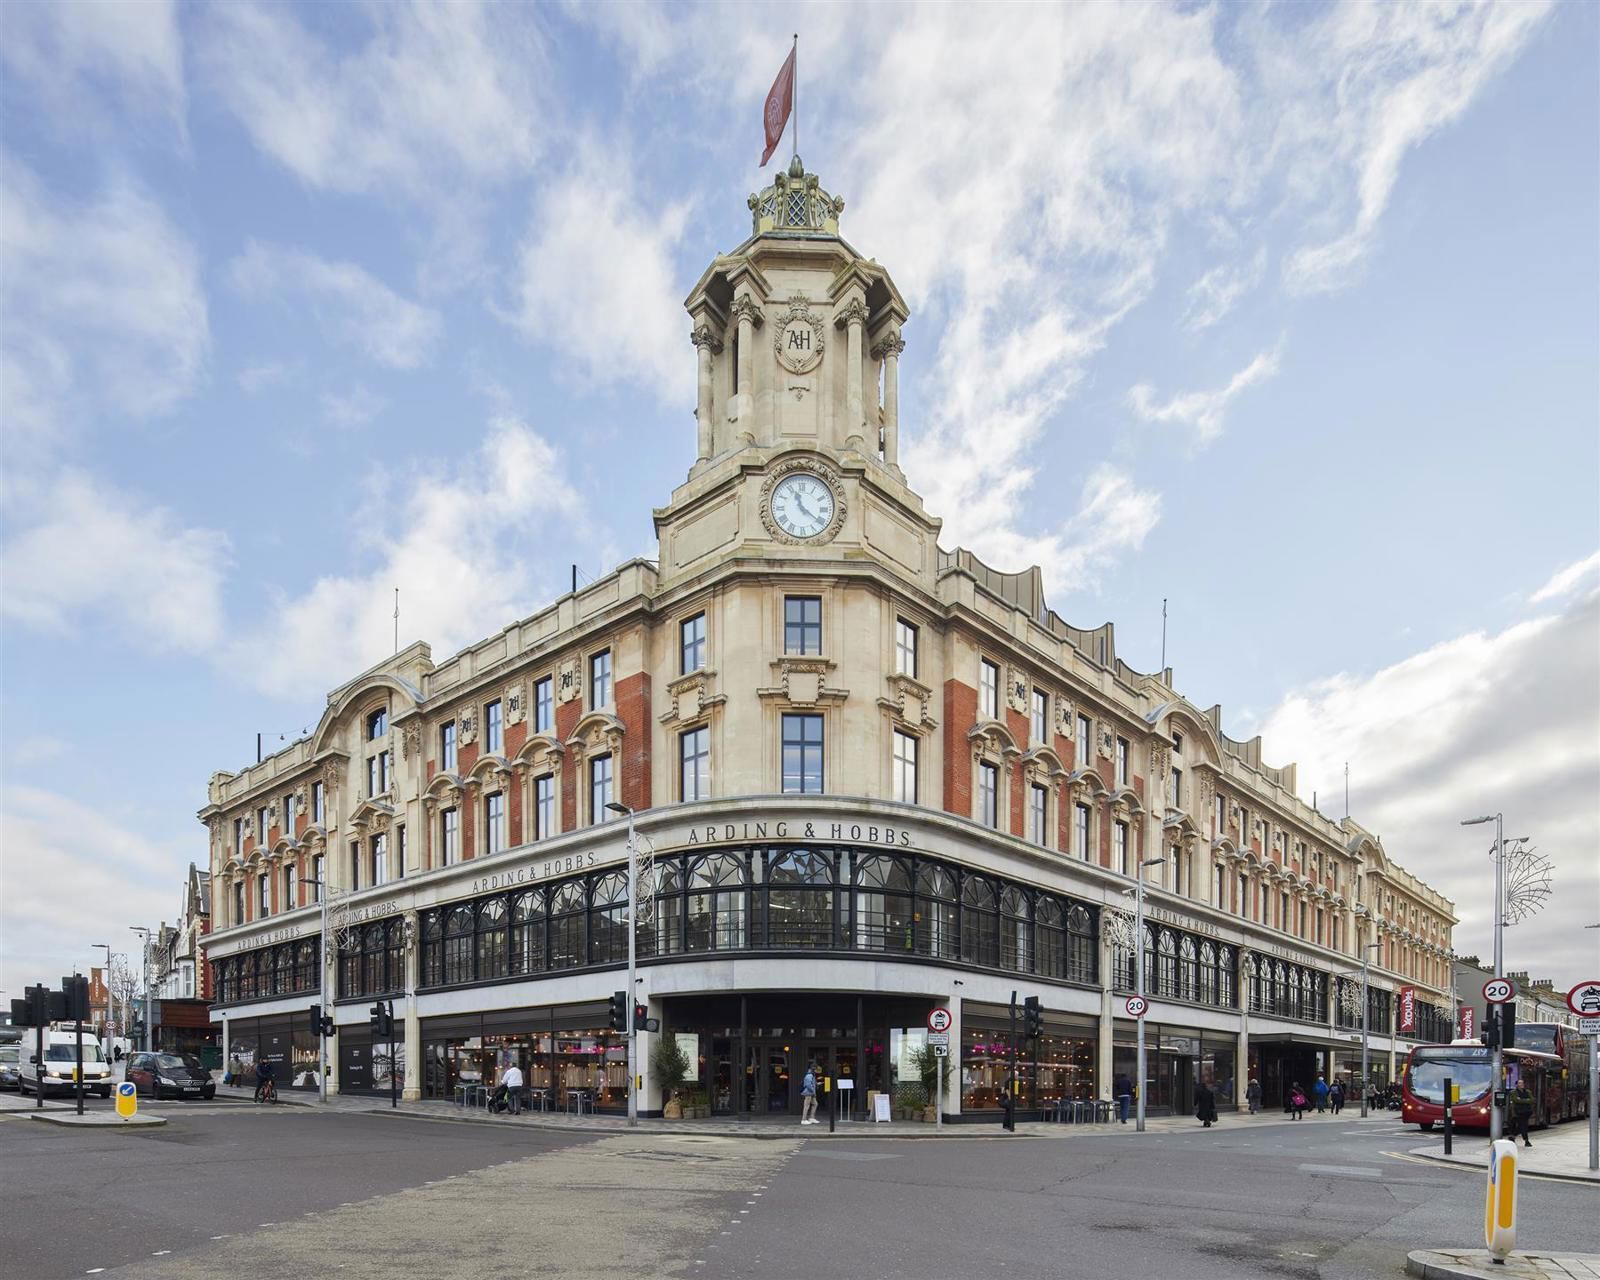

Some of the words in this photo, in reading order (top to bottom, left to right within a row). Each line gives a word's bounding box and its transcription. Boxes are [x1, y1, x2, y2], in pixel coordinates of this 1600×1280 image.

[688, 822, 788, 844] ARDING
[804, 822, 816, 838] &
[831, 823, 910, 847] HOBBS
[472, 869, 524, 893] ARDING
[529, 866, 537, 880] &
[544, 851, 595, 876] HOBBS
[371, 900, 397, 916] HOBBS
[1150, 907, 1183, 926] ARDING
[237, 935, 265, 950] ARDING
[1487, 986, 1508, 996] 20
[1129, 1001, 1143, 1011] 20
